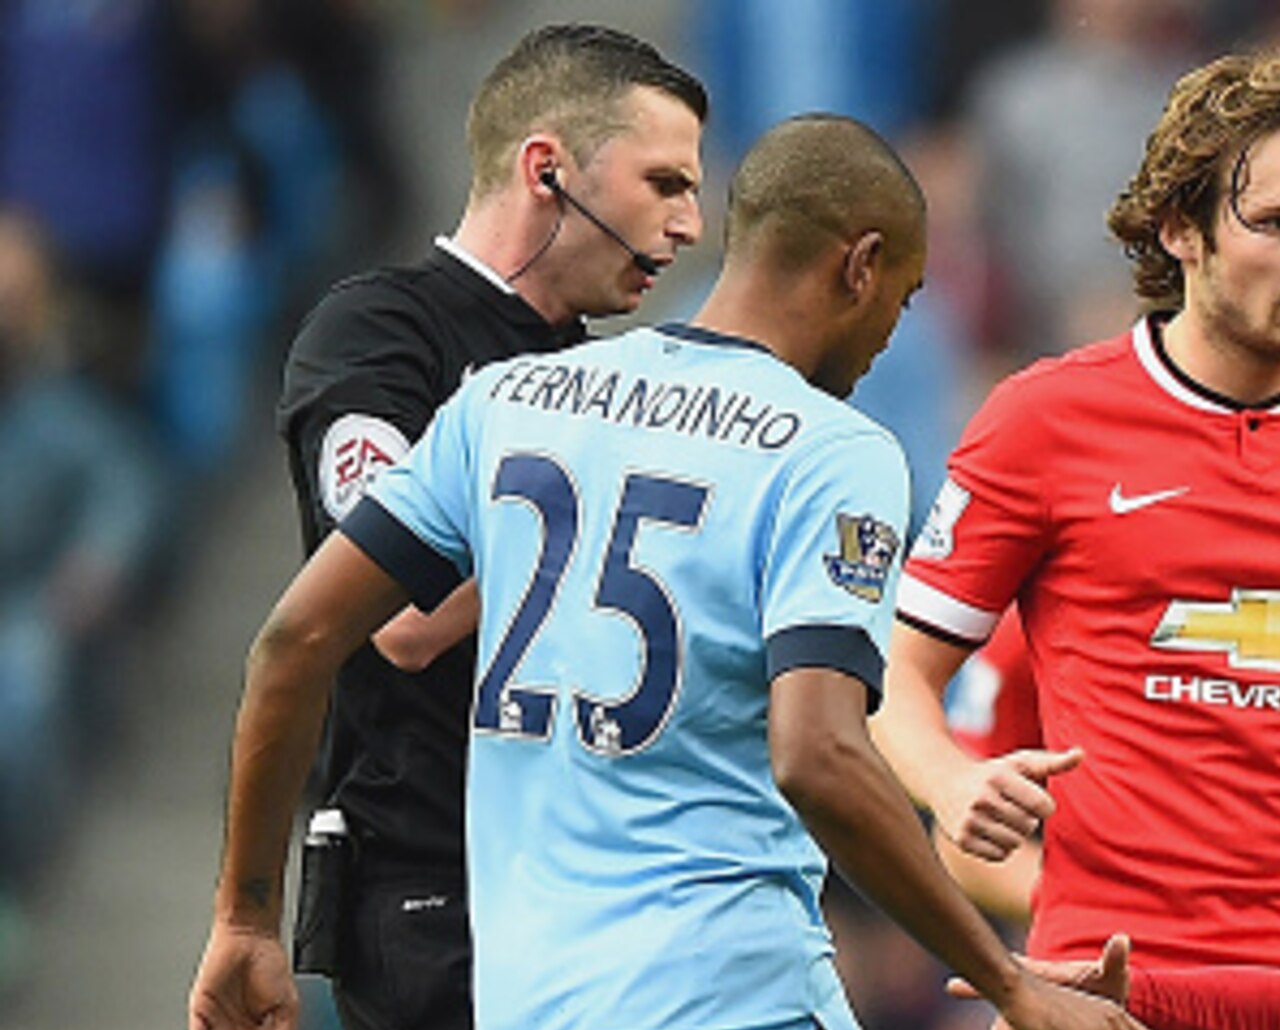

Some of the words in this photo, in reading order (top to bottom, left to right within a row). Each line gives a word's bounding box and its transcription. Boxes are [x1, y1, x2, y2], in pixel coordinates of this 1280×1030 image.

[490, 362, 801, 450] FERNANDINHO
[335, 438, 396, 487] EA
[470, 448, 716, 758] 25
